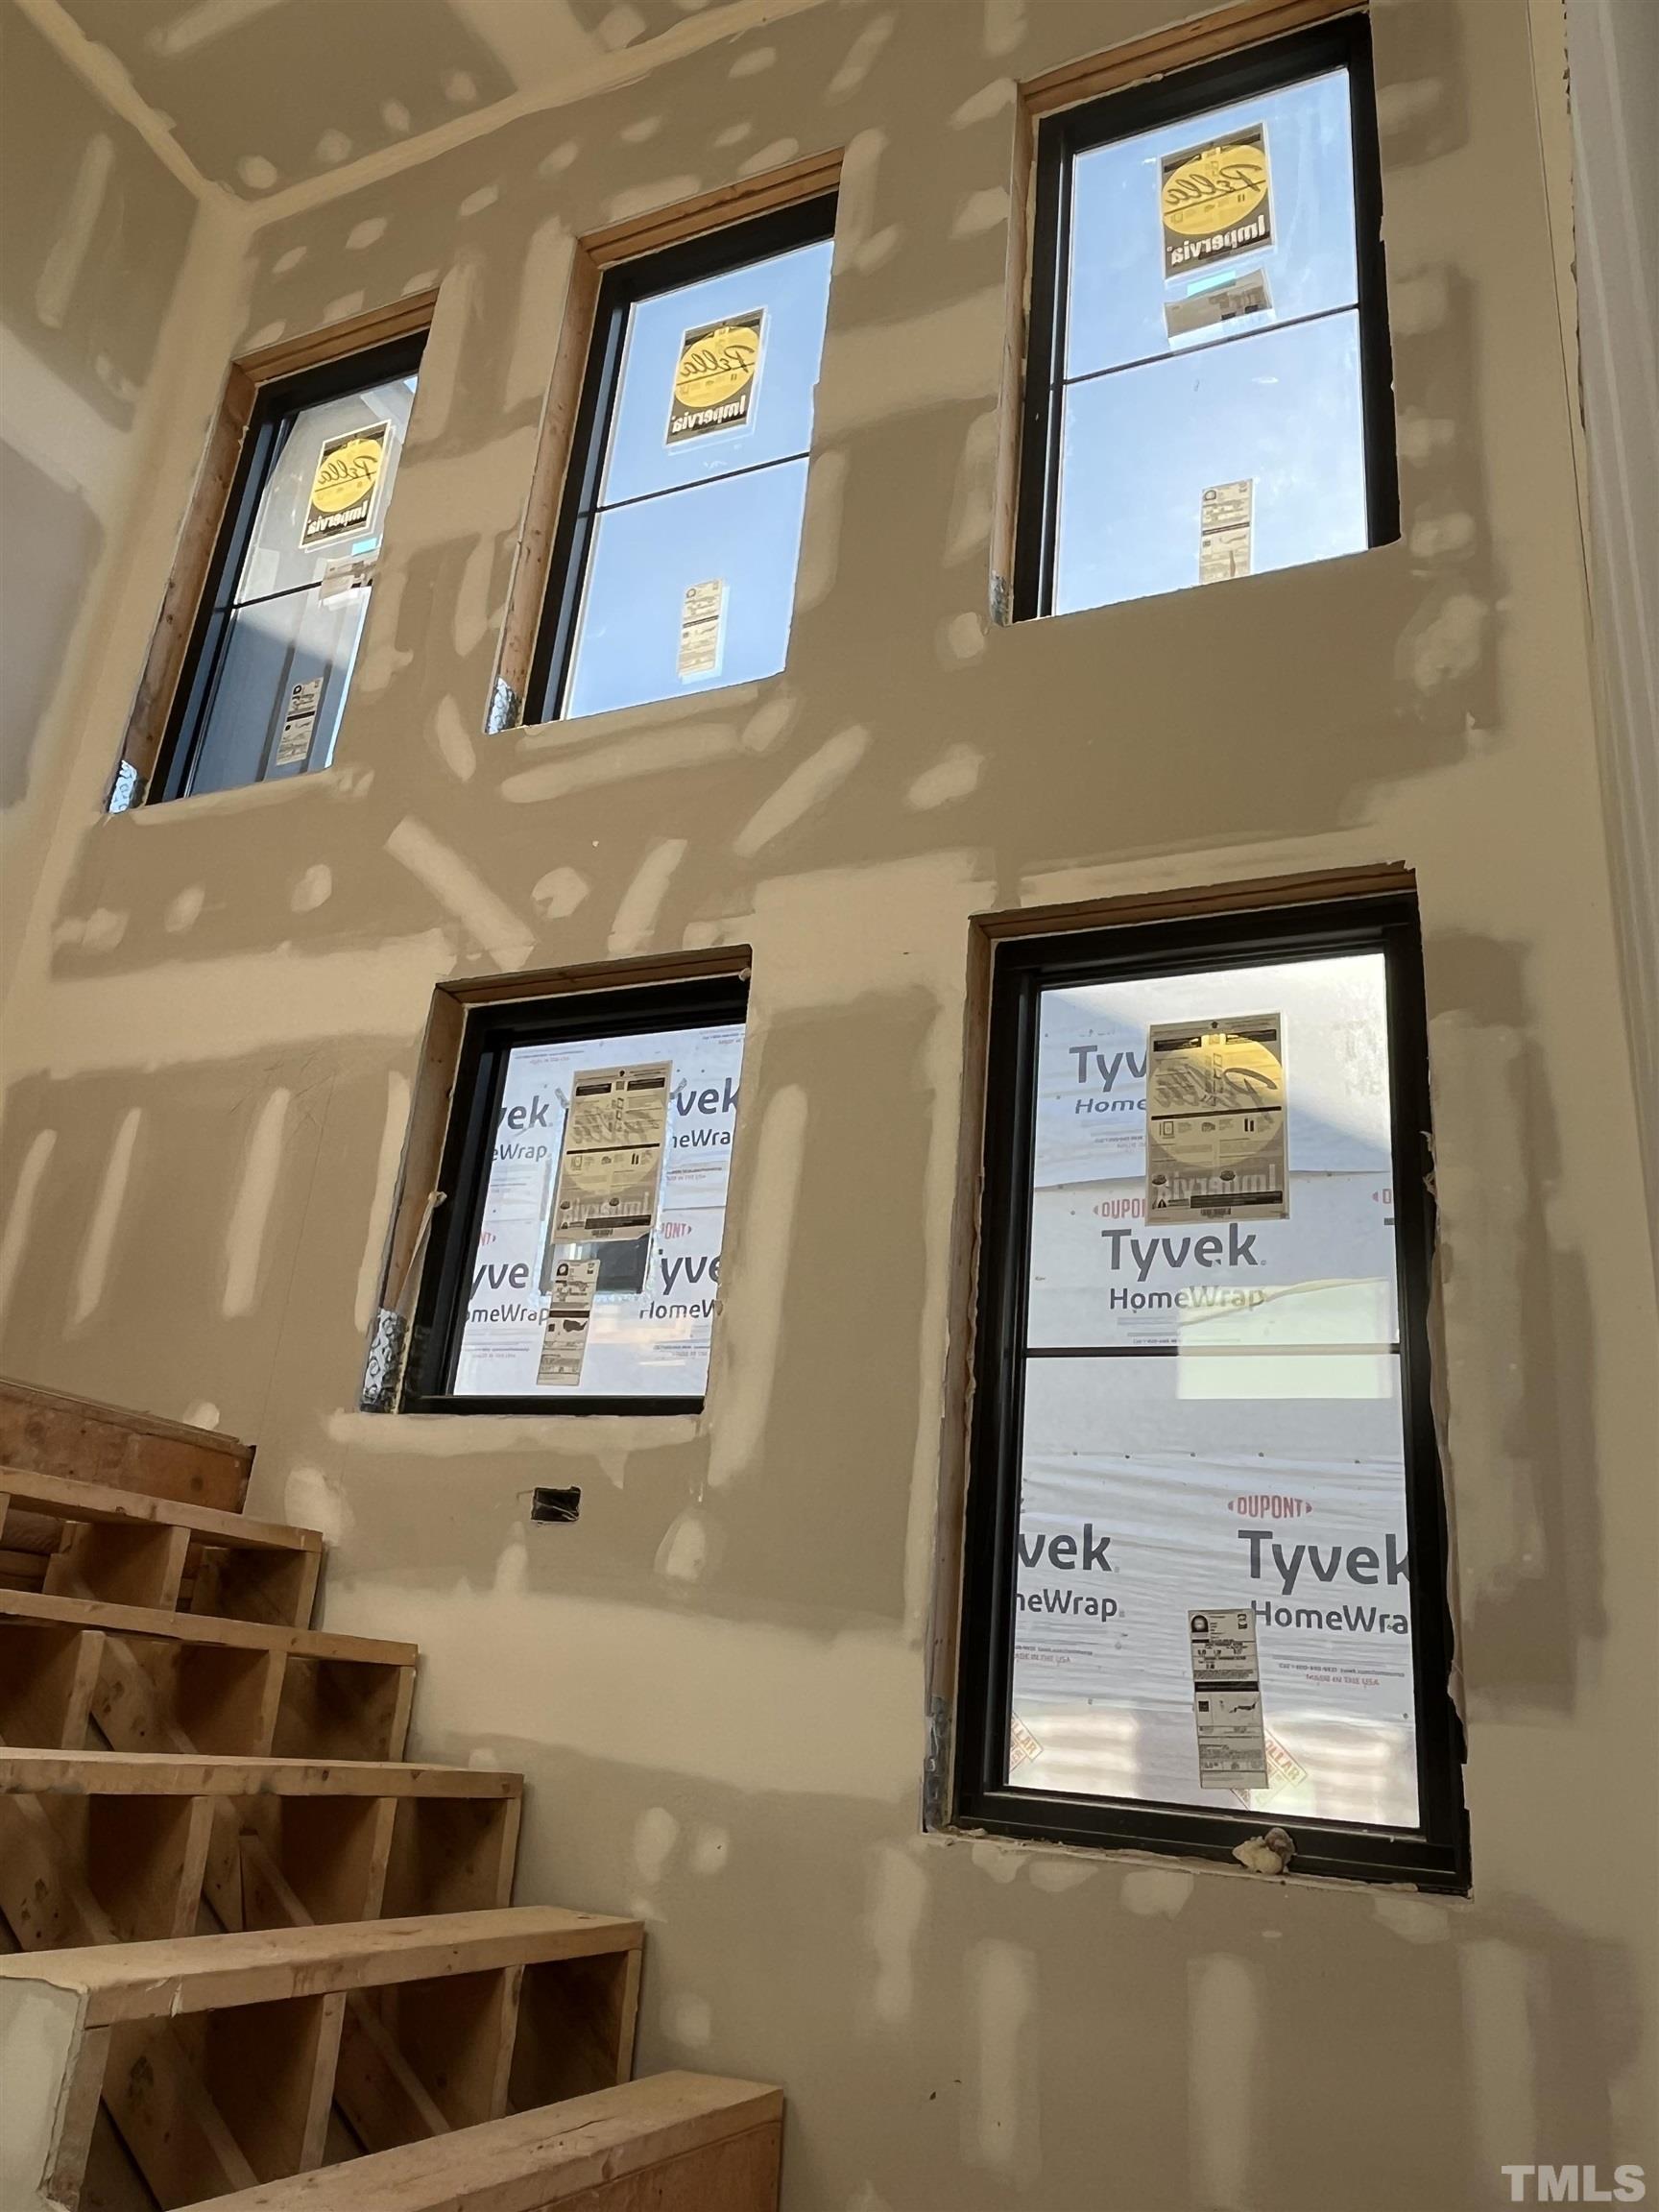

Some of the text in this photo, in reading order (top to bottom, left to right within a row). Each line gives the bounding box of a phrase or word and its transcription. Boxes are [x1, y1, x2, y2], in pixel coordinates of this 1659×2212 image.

[1101, 1223, 1259, 1282] Tyvek
[1110, 1285, 1265, 1310] HomeWrap
[467, 1304, 550, 1326] meWrap
[1237, 1495, 1304, 1519] DUPONT
[1238, 1529, 1410, 1596] Tyvek
